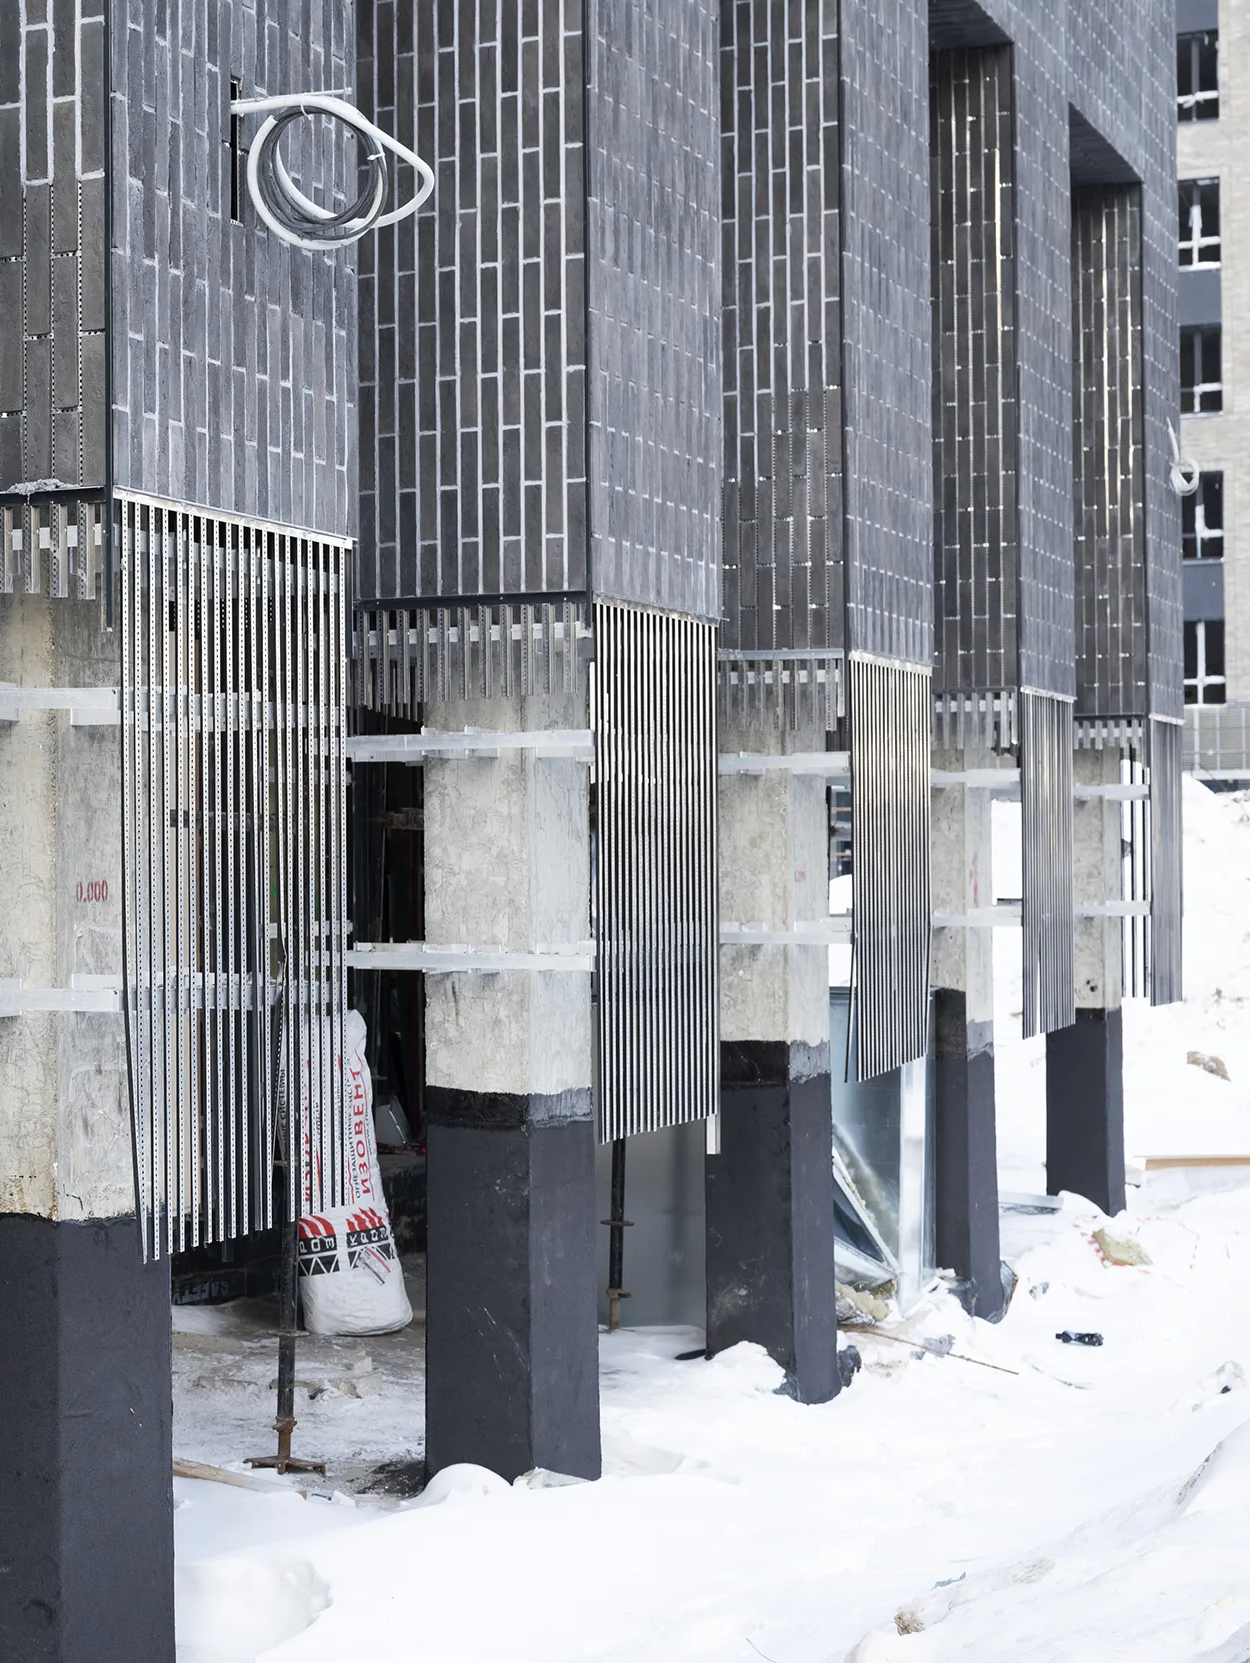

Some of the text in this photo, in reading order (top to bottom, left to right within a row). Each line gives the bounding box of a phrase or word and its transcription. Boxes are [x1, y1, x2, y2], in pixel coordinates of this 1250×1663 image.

[75, 879, 109, 903] 0.000
[351, 1067, 371, 1195] ИЗОВЕНТ
[299, 1237, 335, 1253] РОЗ
